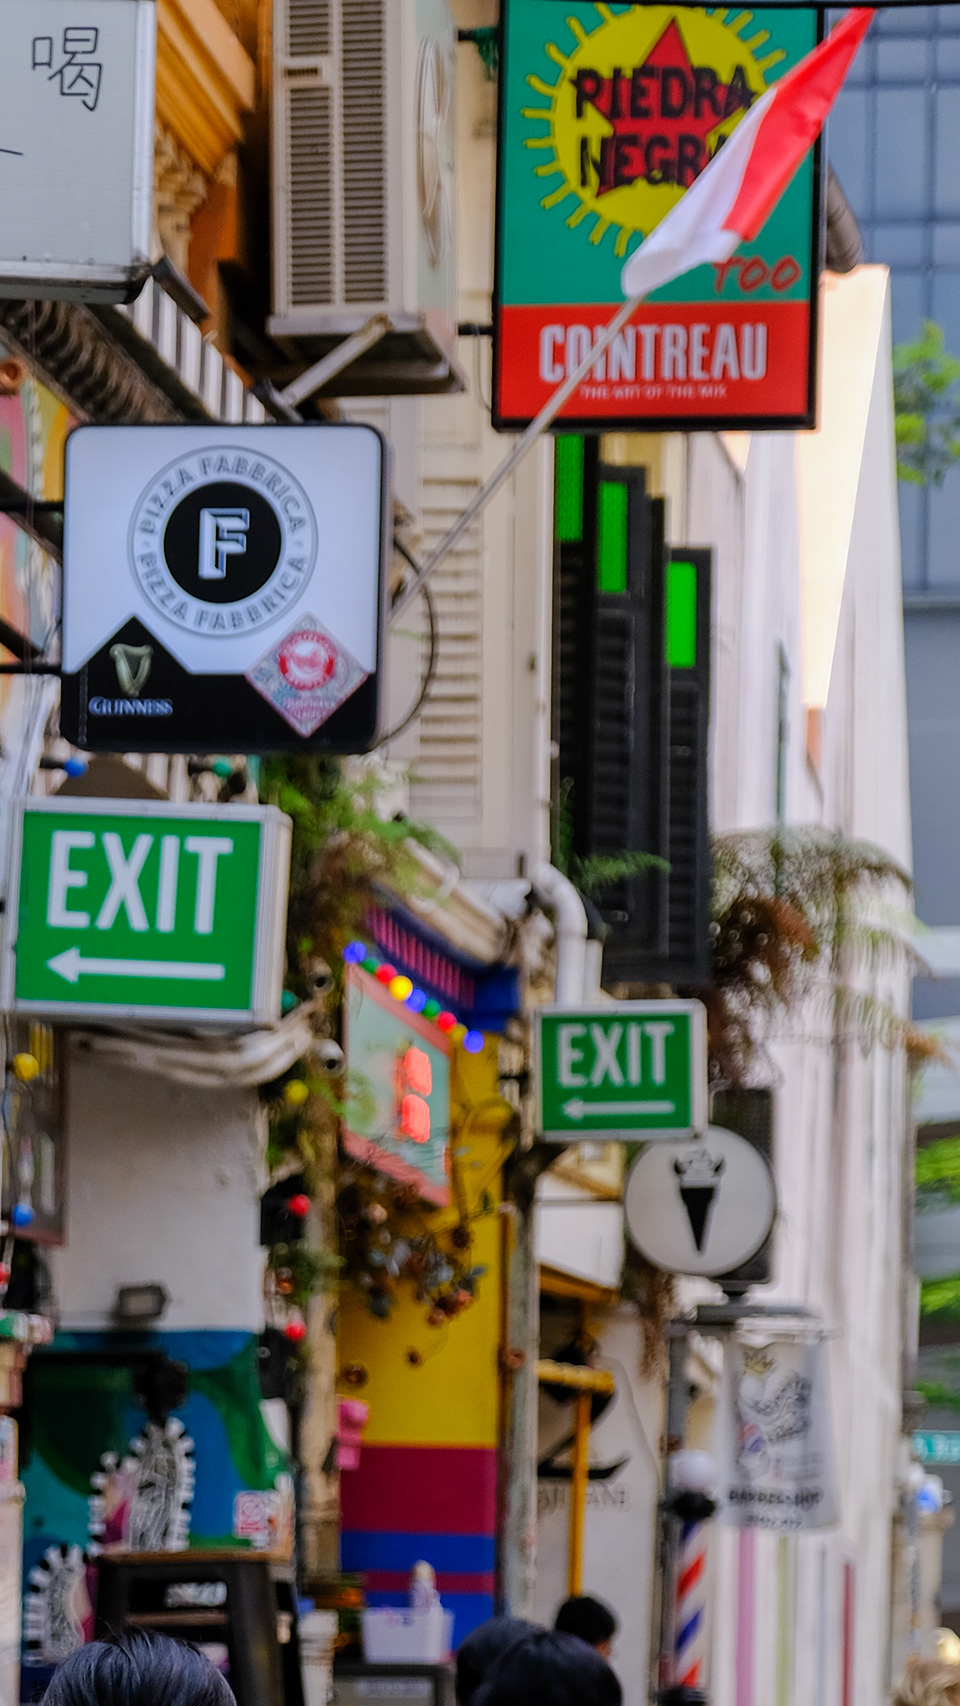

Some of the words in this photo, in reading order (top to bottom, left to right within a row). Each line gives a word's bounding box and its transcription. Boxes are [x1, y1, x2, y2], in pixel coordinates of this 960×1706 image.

[33, 27, 101, 112] 喝
[573, 66, 752, 120] PIEDRA
[580, 134, 726, 188] NEGR
[541, 323, 768, 383] COINTREAU
[141, 467, 194, 535] PIZZA
[200, 455, 306, 533] FABBRICA
[141, 552, 189, 621] PIZZA
[195, 556, 305, 630] FABBRICA
[90, 697, 173, 716] GUINNESS
[47, 830, 234, 935] EXIT
[557, 1021, 675, 1088] EXIT
